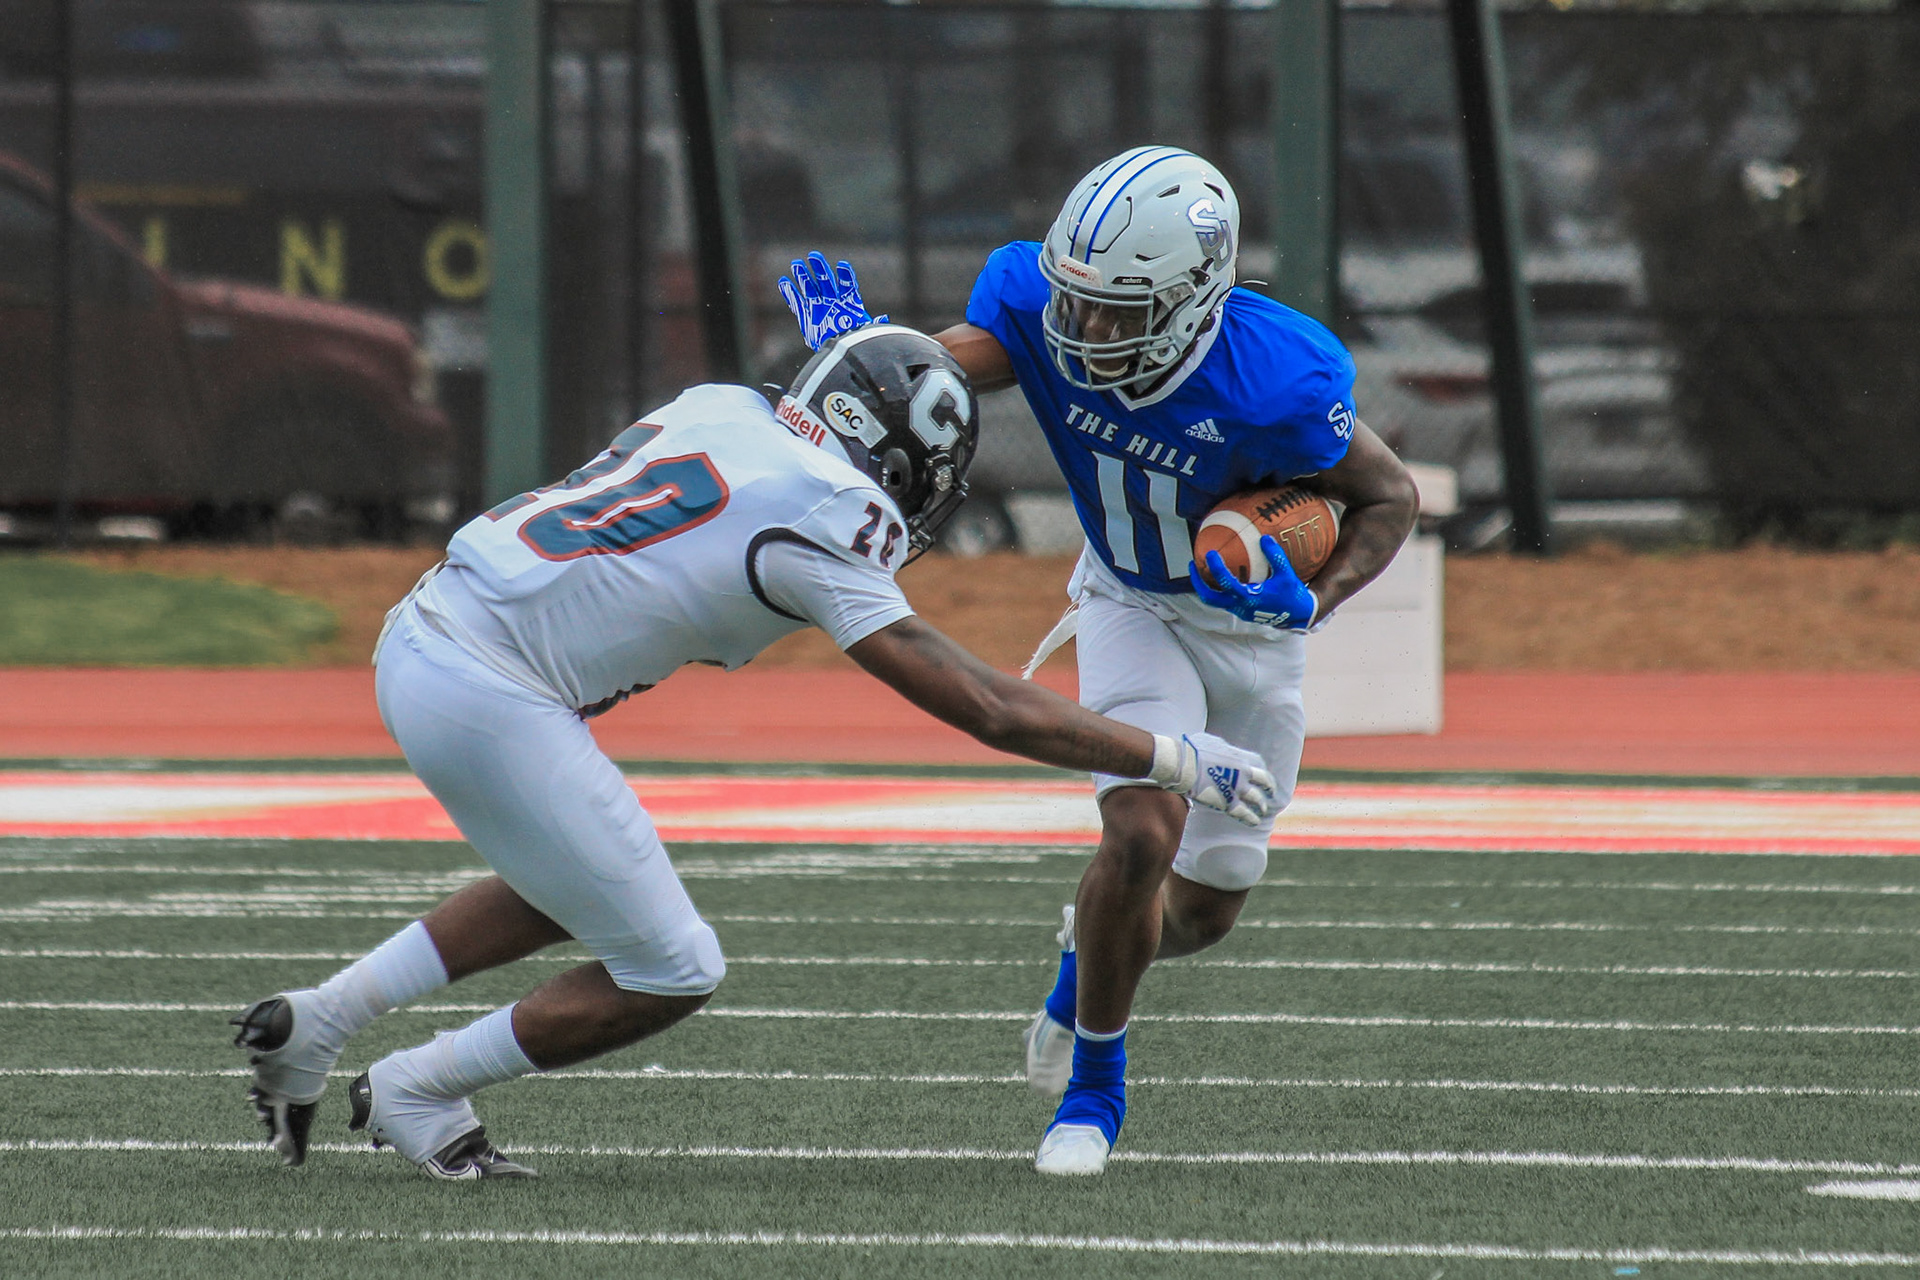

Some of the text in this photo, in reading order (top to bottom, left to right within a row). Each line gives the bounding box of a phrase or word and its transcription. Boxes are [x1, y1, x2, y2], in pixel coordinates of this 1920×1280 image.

[830, 398, 863, 430] SAC
[909, 368, 971, 450] C
[1185, 428, 1225, 443] adidas
[1066, 403, 1197, 476] THE HILL
[1091, 451, 1194, 580] 11
[1207, 767, 1234, 803] adidas
